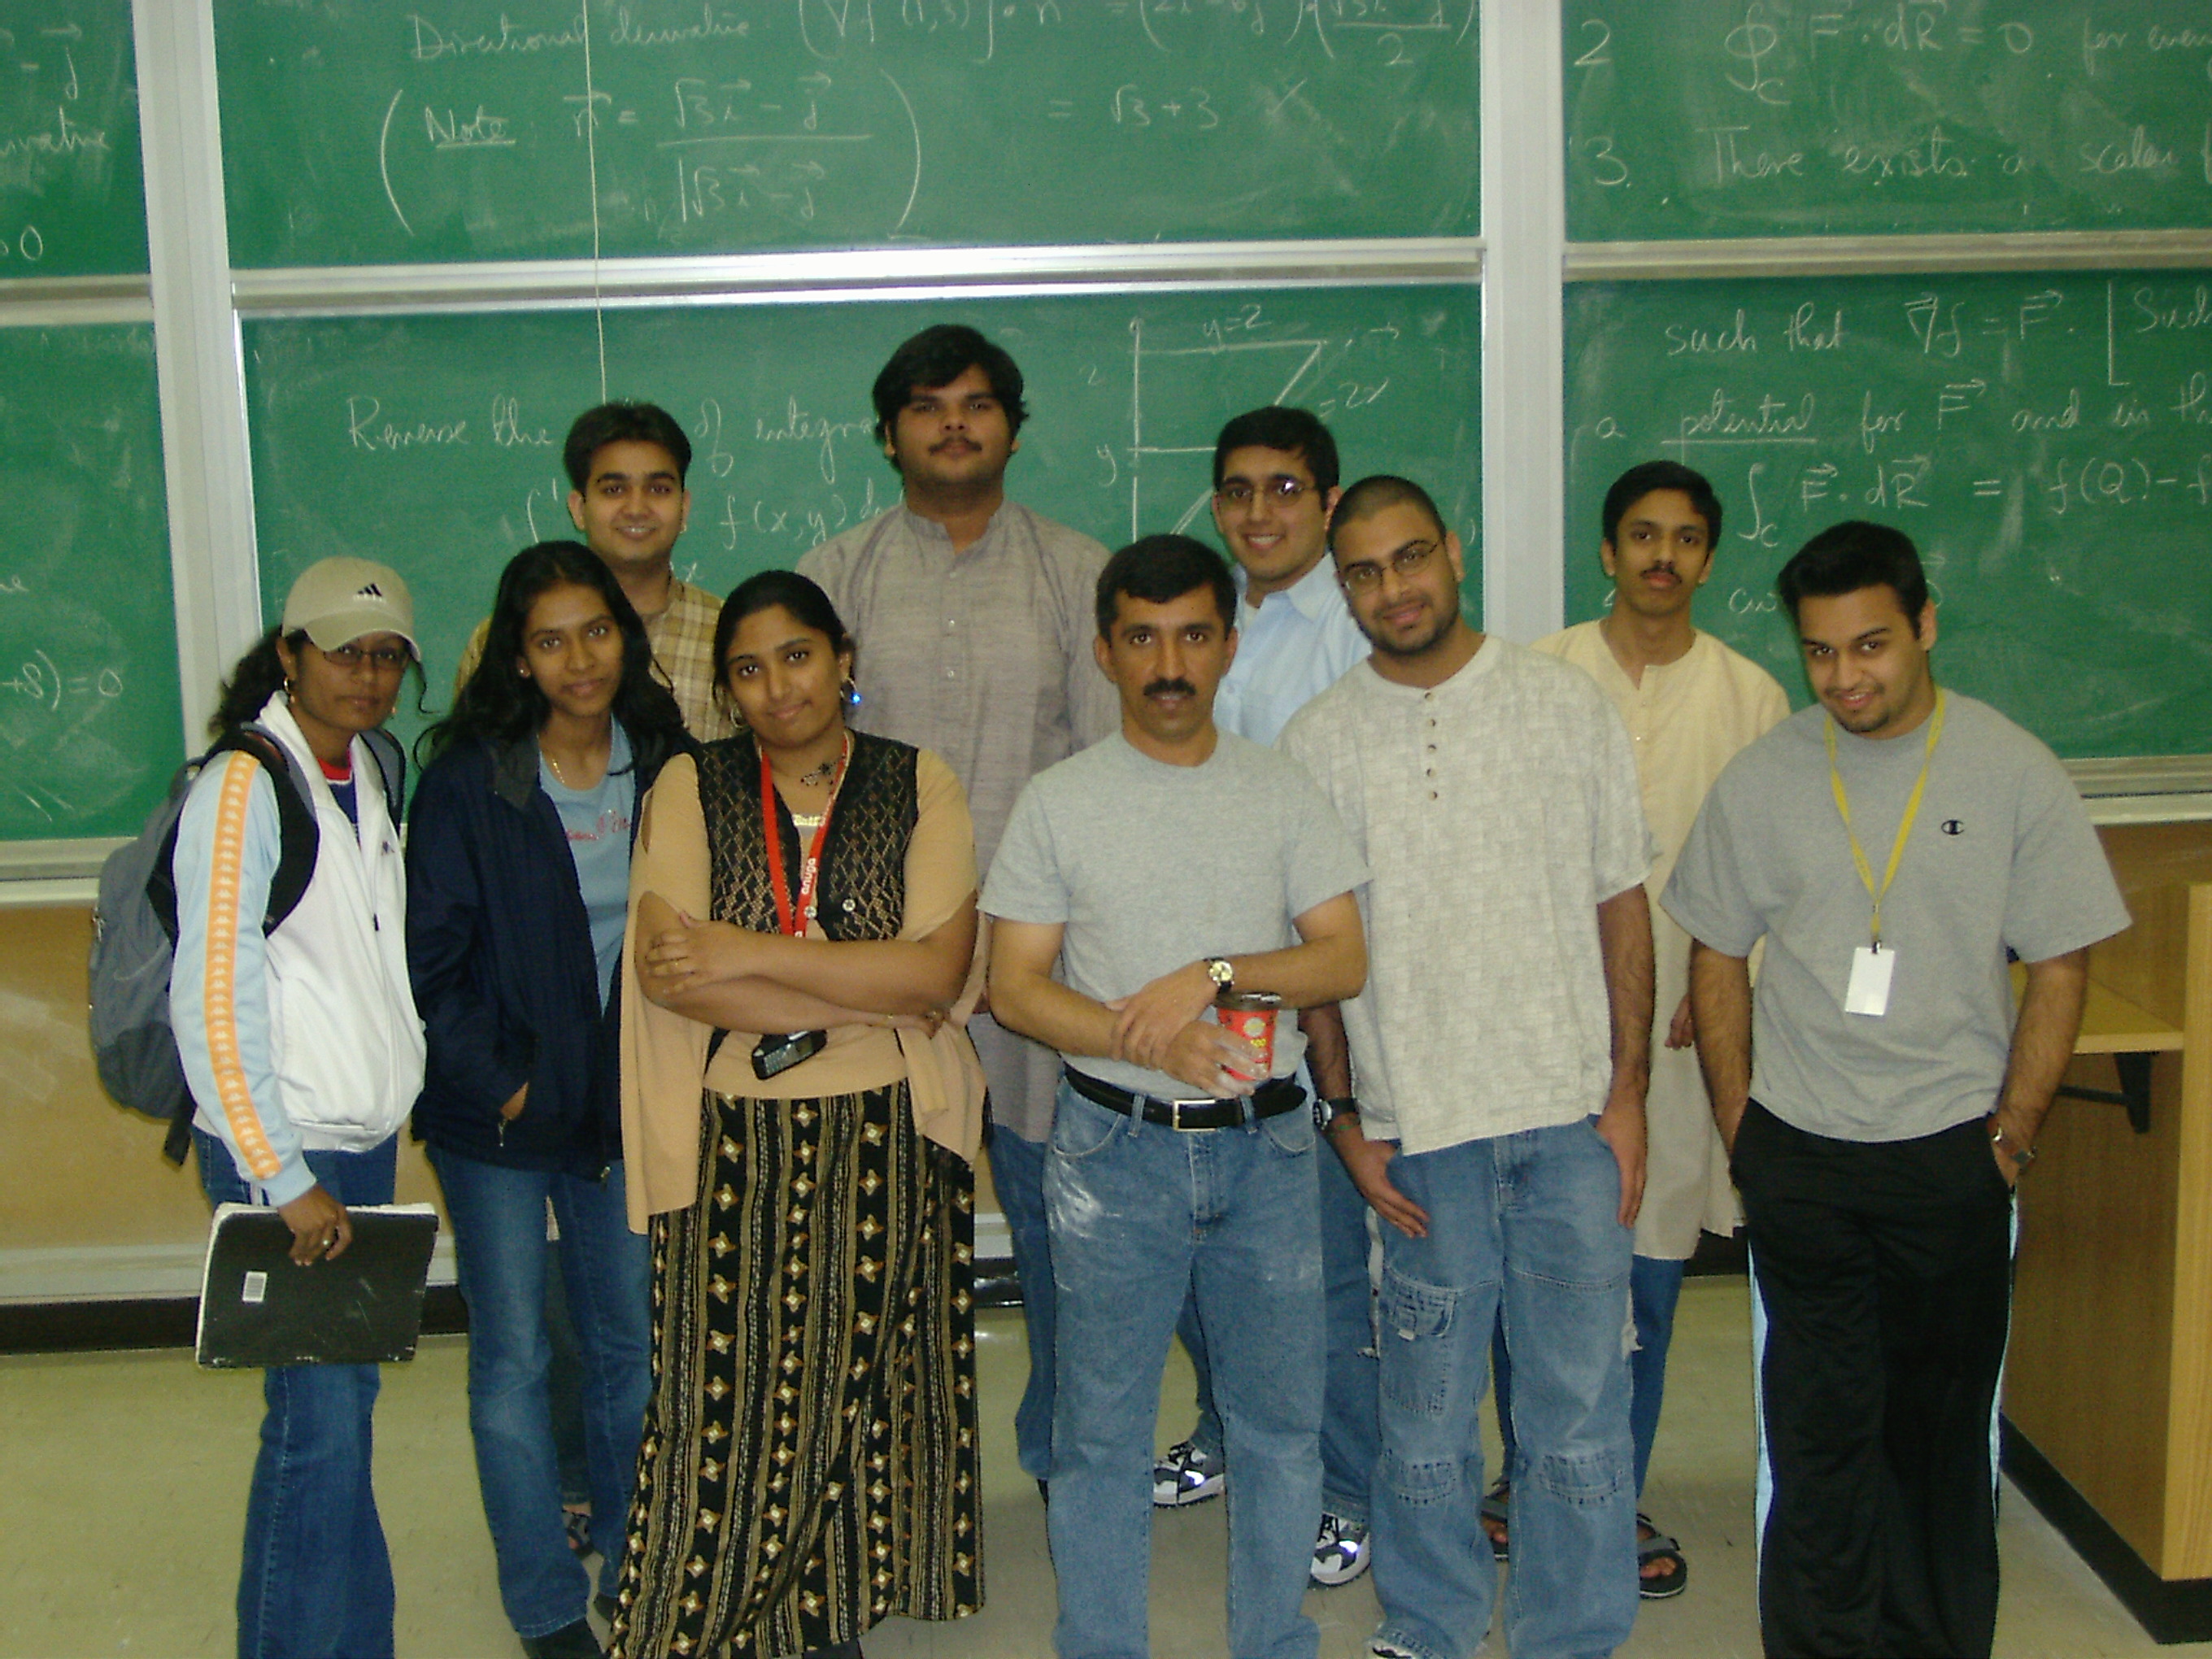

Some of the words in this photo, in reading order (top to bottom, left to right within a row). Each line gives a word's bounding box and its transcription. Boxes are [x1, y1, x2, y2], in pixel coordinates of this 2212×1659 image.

[1573, 18, 1612, 67] 2
[425, 104, 516, 150] Note
[1695, 124, 1806, 185] There
[1666, 308, 1758, 356] such
[1783, 301, 1849, 351] that
[491, 393, 554, 447] the
[1595, 416, 1626, 439] a
[1659, 387, 1818, 464] potential
[1861, 389, 1906, 455] for
[2012, 386, 2081, 432] and
[2112, 397, 2149, 428] in
